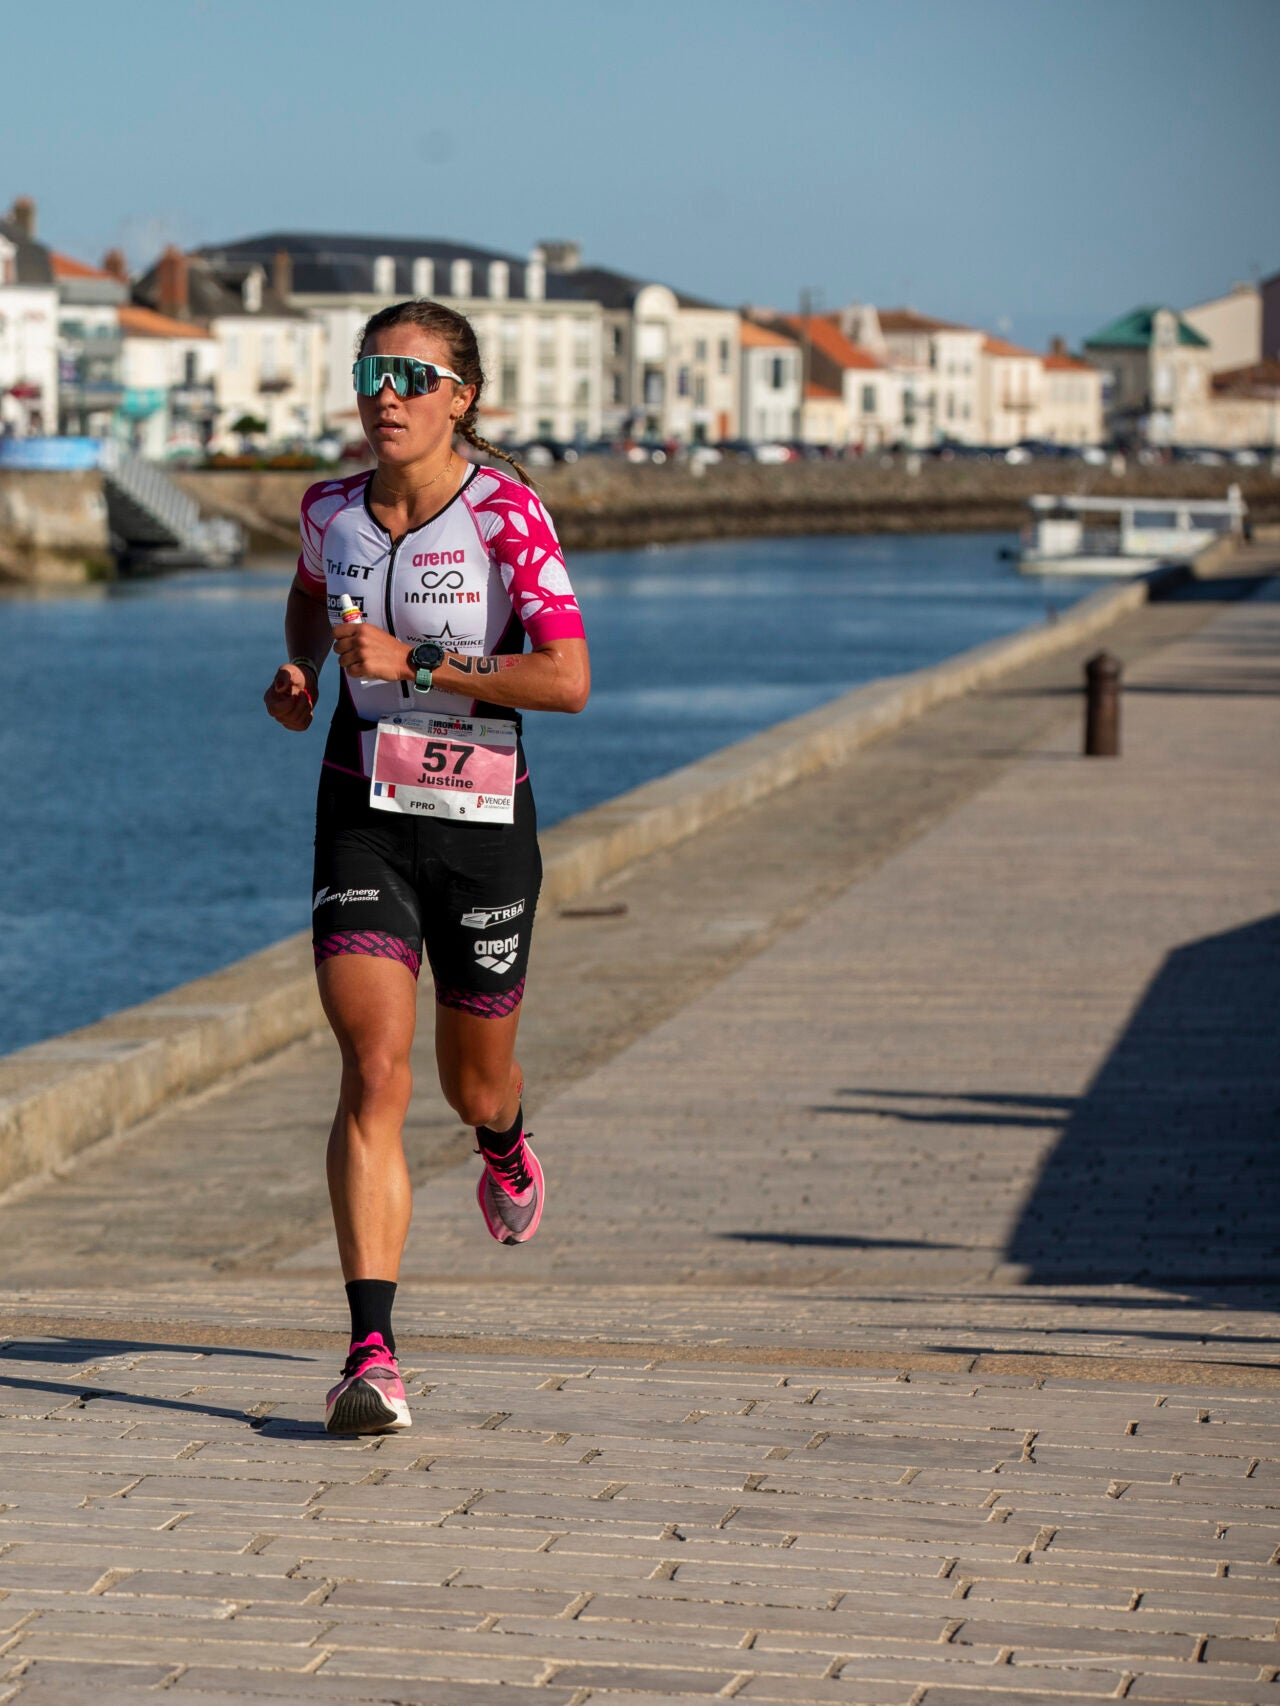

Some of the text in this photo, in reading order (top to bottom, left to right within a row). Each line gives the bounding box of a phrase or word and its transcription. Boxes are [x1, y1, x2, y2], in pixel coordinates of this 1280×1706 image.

[412, 549, 465, 567] arena
[326, 559, 374, 581] Tri.GT
[404, 591, 481, 604] INFINITRI
[447, 655, 499, 675] 57
[432, 727, 448, 736] 70.3
[433, 719, 473, 731] IRONMAN
[421, 741, 475, 775] 57
[417, 773, 474, 789] Justine
[409, 800, 466, 814] FPRO S
[346, 888, 380, 897] Energy
[474, 933, 519, 955] arena
